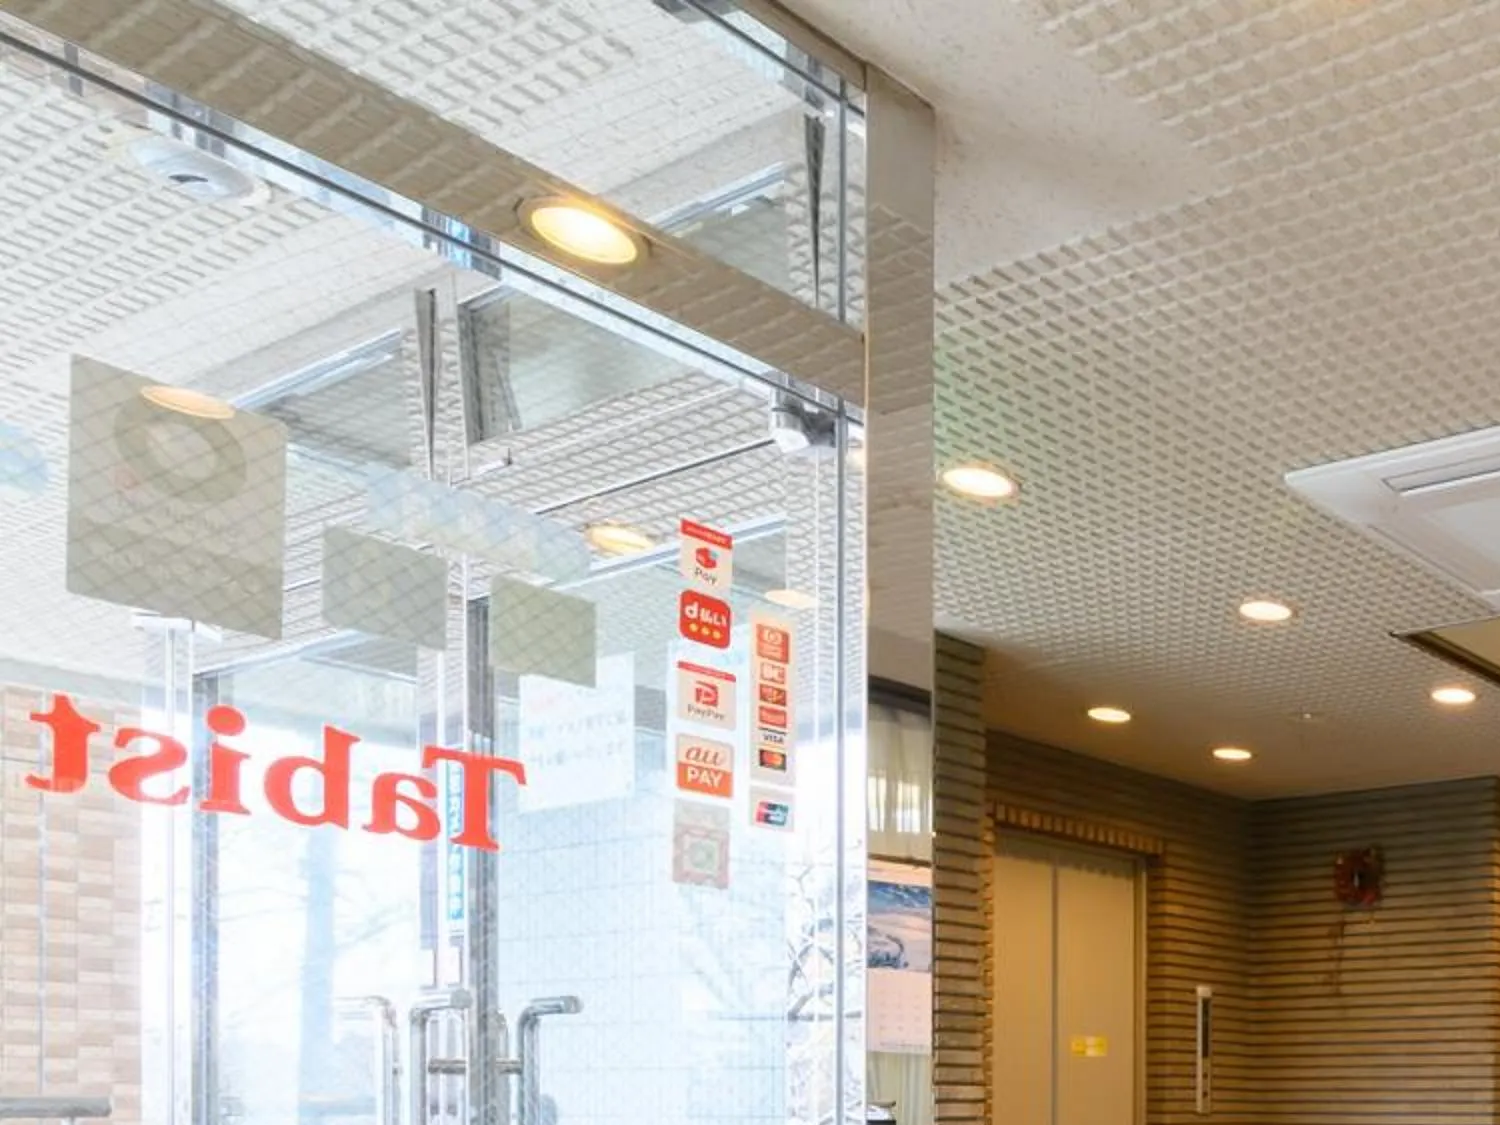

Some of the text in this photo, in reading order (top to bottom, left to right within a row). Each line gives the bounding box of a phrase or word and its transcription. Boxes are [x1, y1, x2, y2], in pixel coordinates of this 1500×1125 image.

[694, 567, 718, 585] Pay
[687, 703, 725, 721] PayPay
[763, 732, 785, 745] VISA
[685, 746, 724, 767] au
[687, 767, 723, 788] PAY
